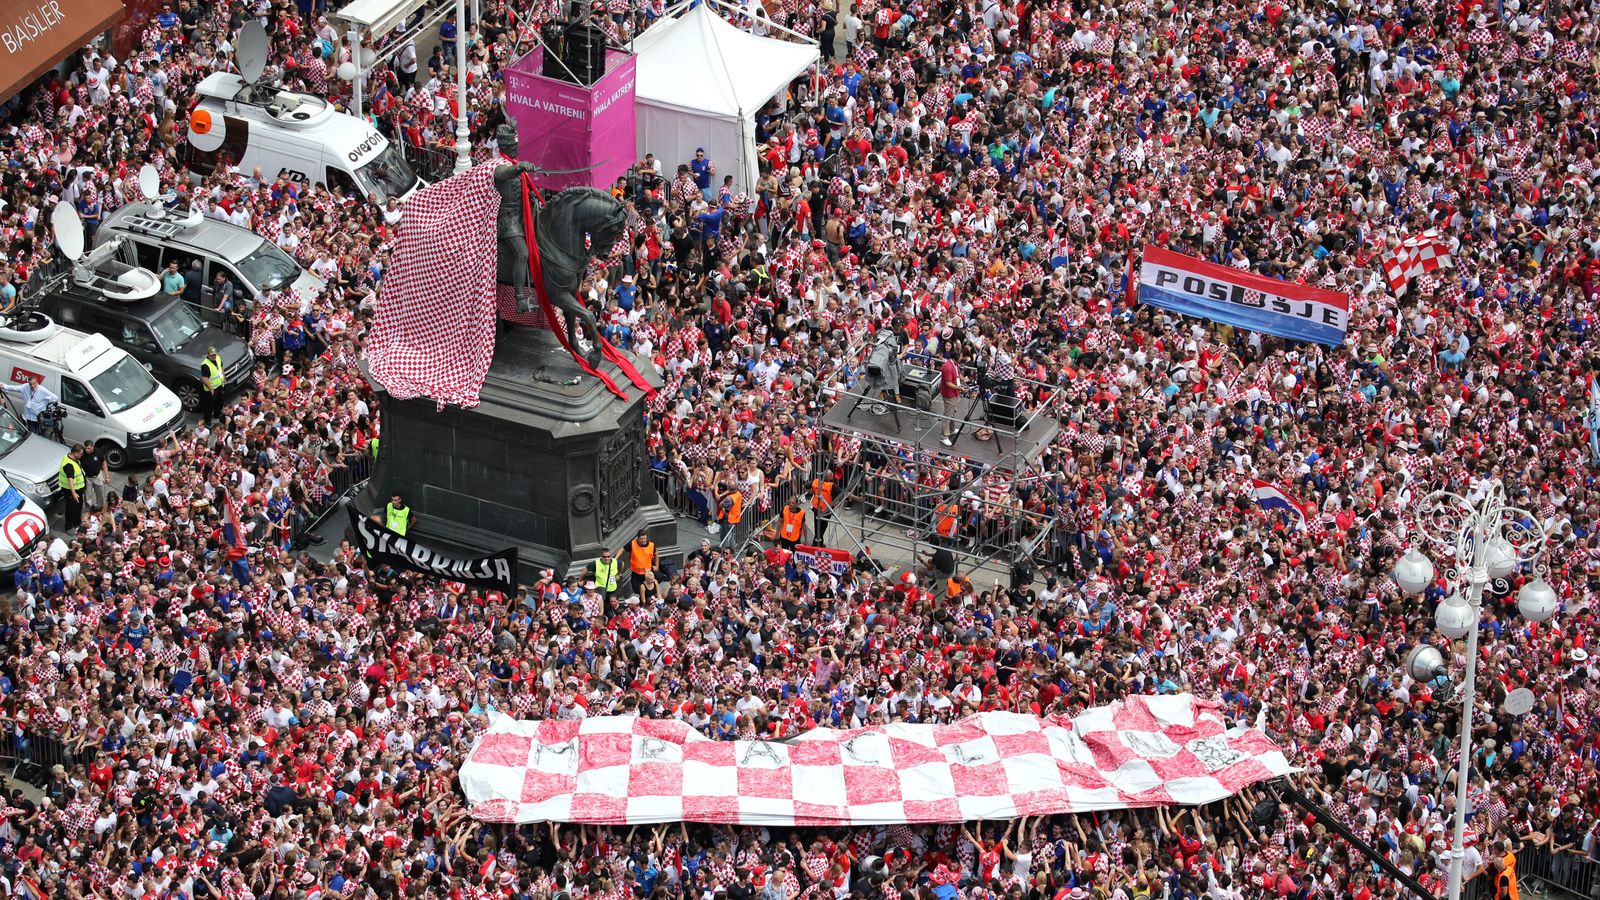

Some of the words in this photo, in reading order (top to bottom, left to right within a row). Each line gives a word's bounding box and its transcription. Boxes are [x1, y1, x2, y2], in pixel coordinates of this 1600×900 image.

[509, 92, 541, 109] HVALA
[543, 101, 585, 120] VATRENI!
[593, 95, 611, 118] HVALA
[1155, 270, 1339, 327] POSUŠJE
